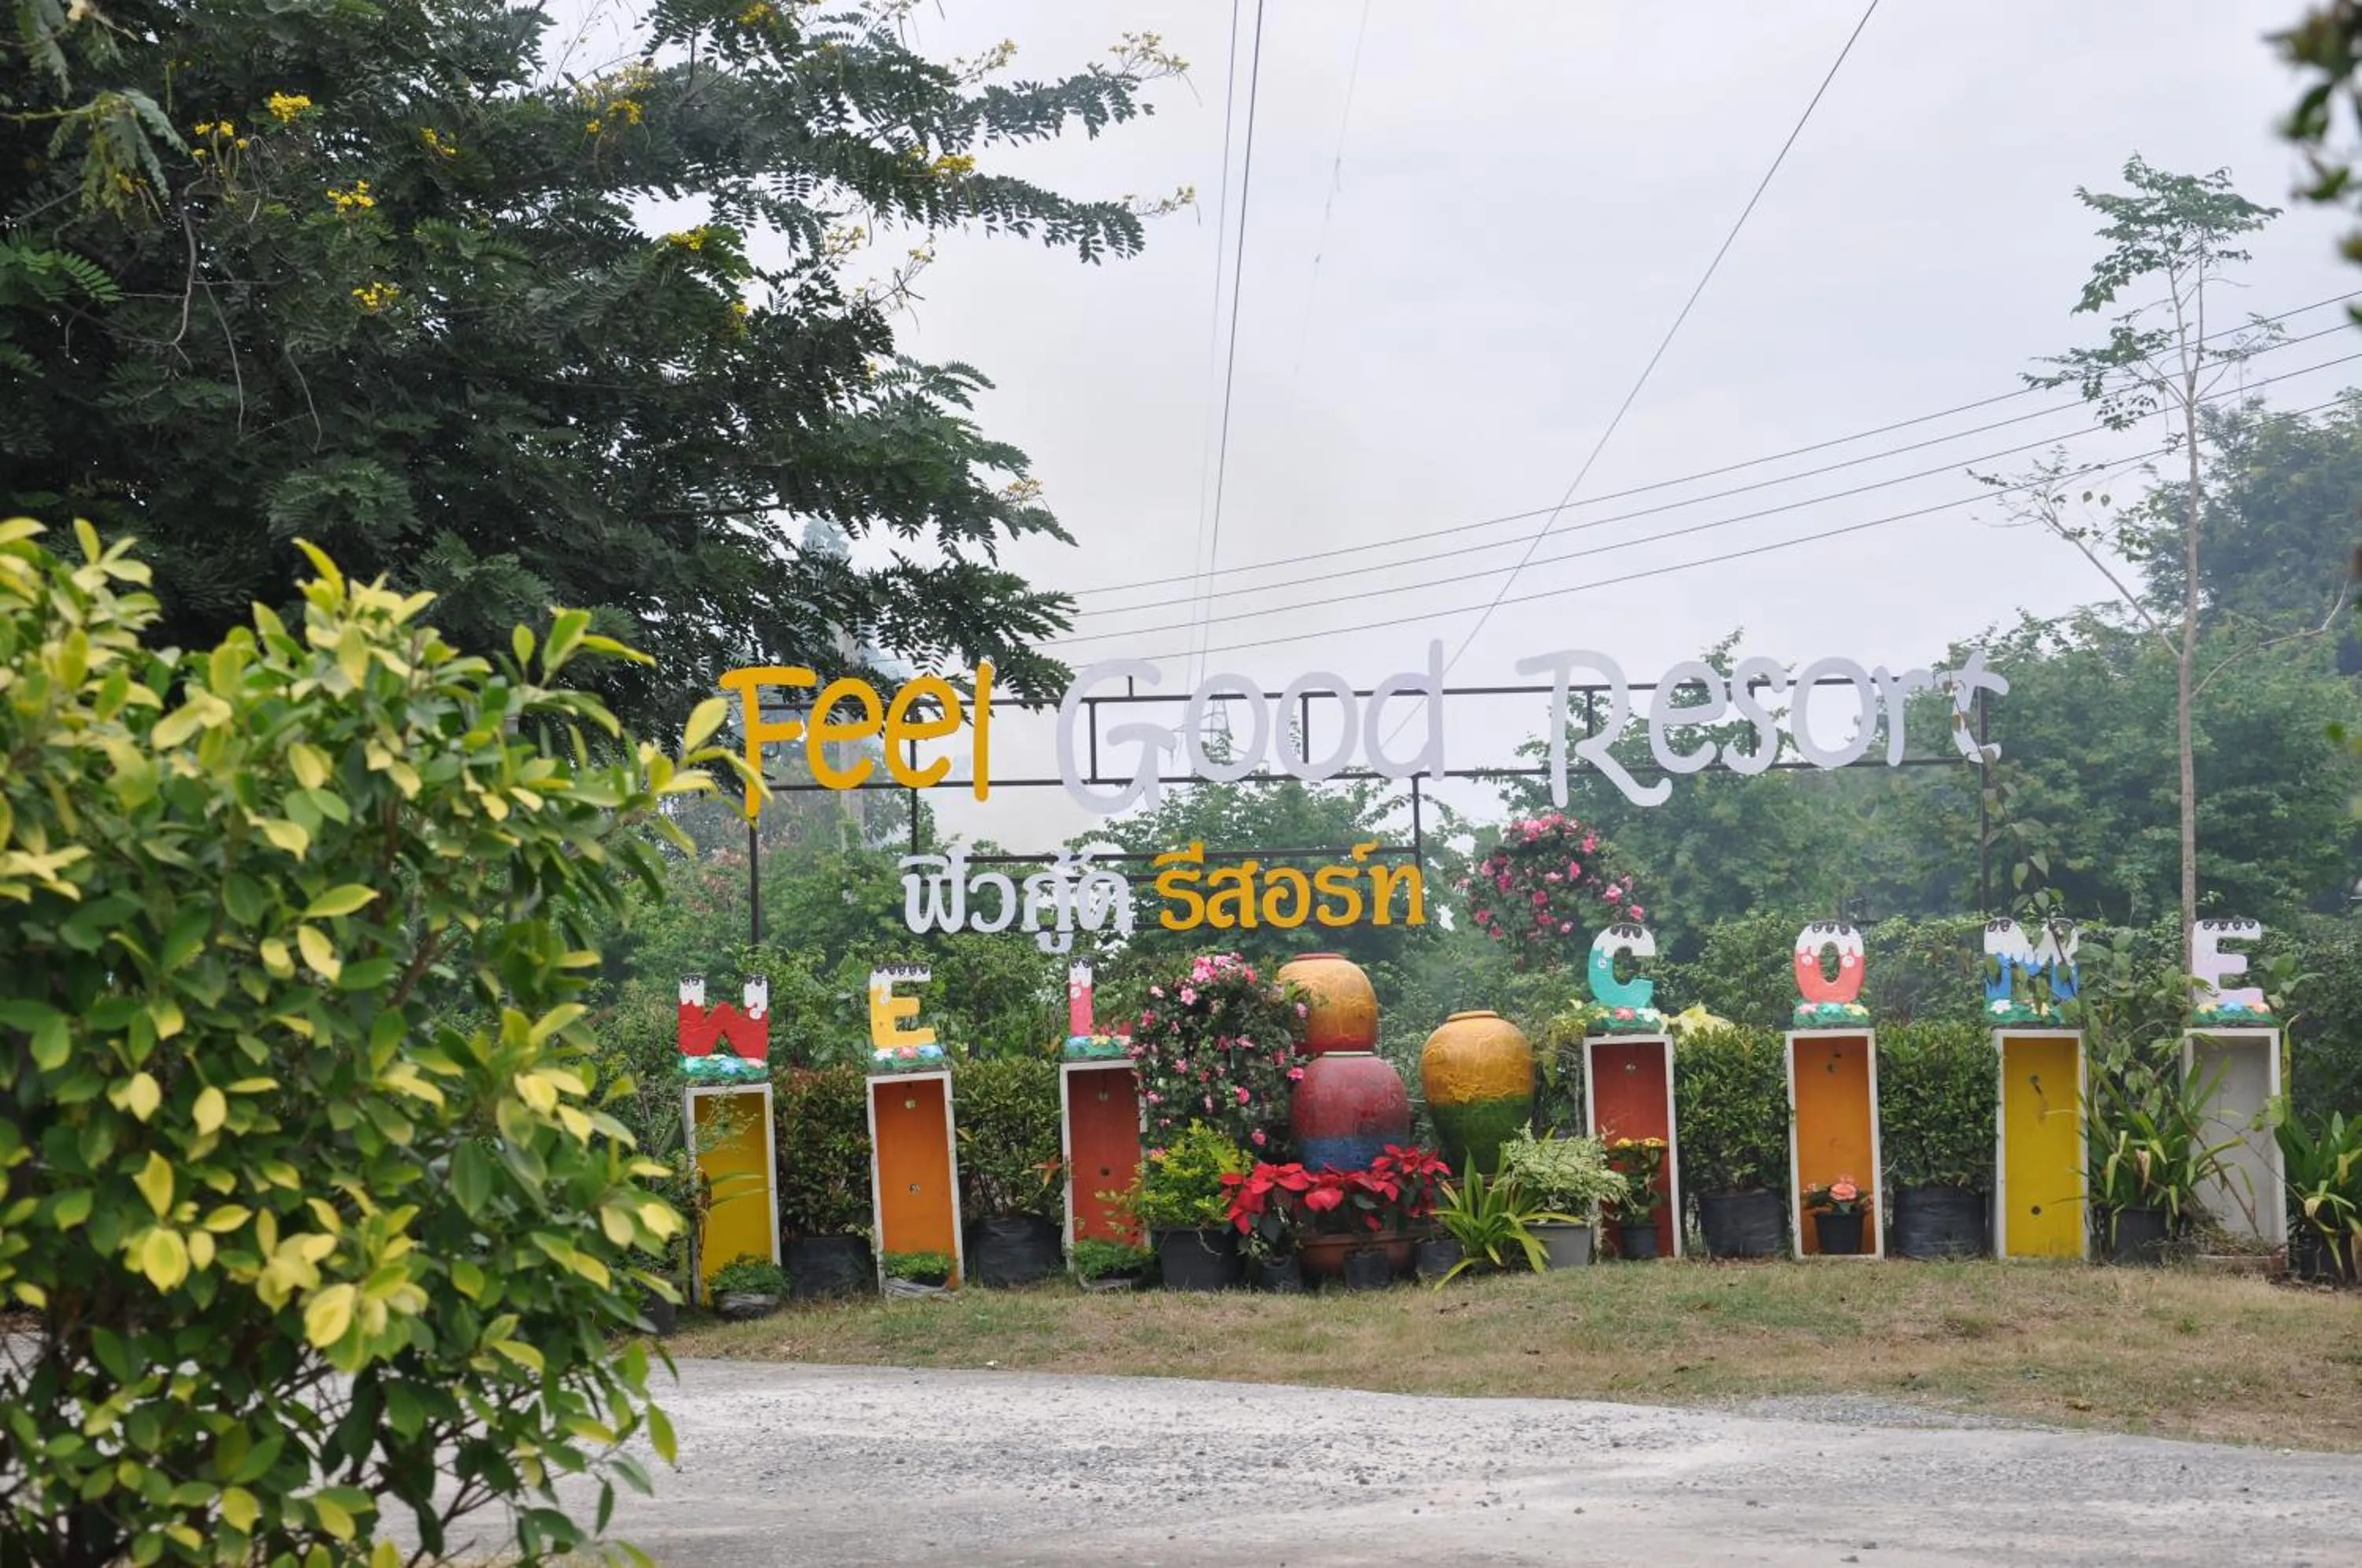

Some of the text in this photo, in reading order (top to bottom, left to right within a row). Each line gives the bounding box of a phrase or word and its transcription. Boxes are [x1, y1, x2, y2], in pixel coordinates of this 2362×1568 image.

[719, 638, 2009, 818] Feel Good Resort
[1153, 840, 1426, 931] รีสอร์ท
